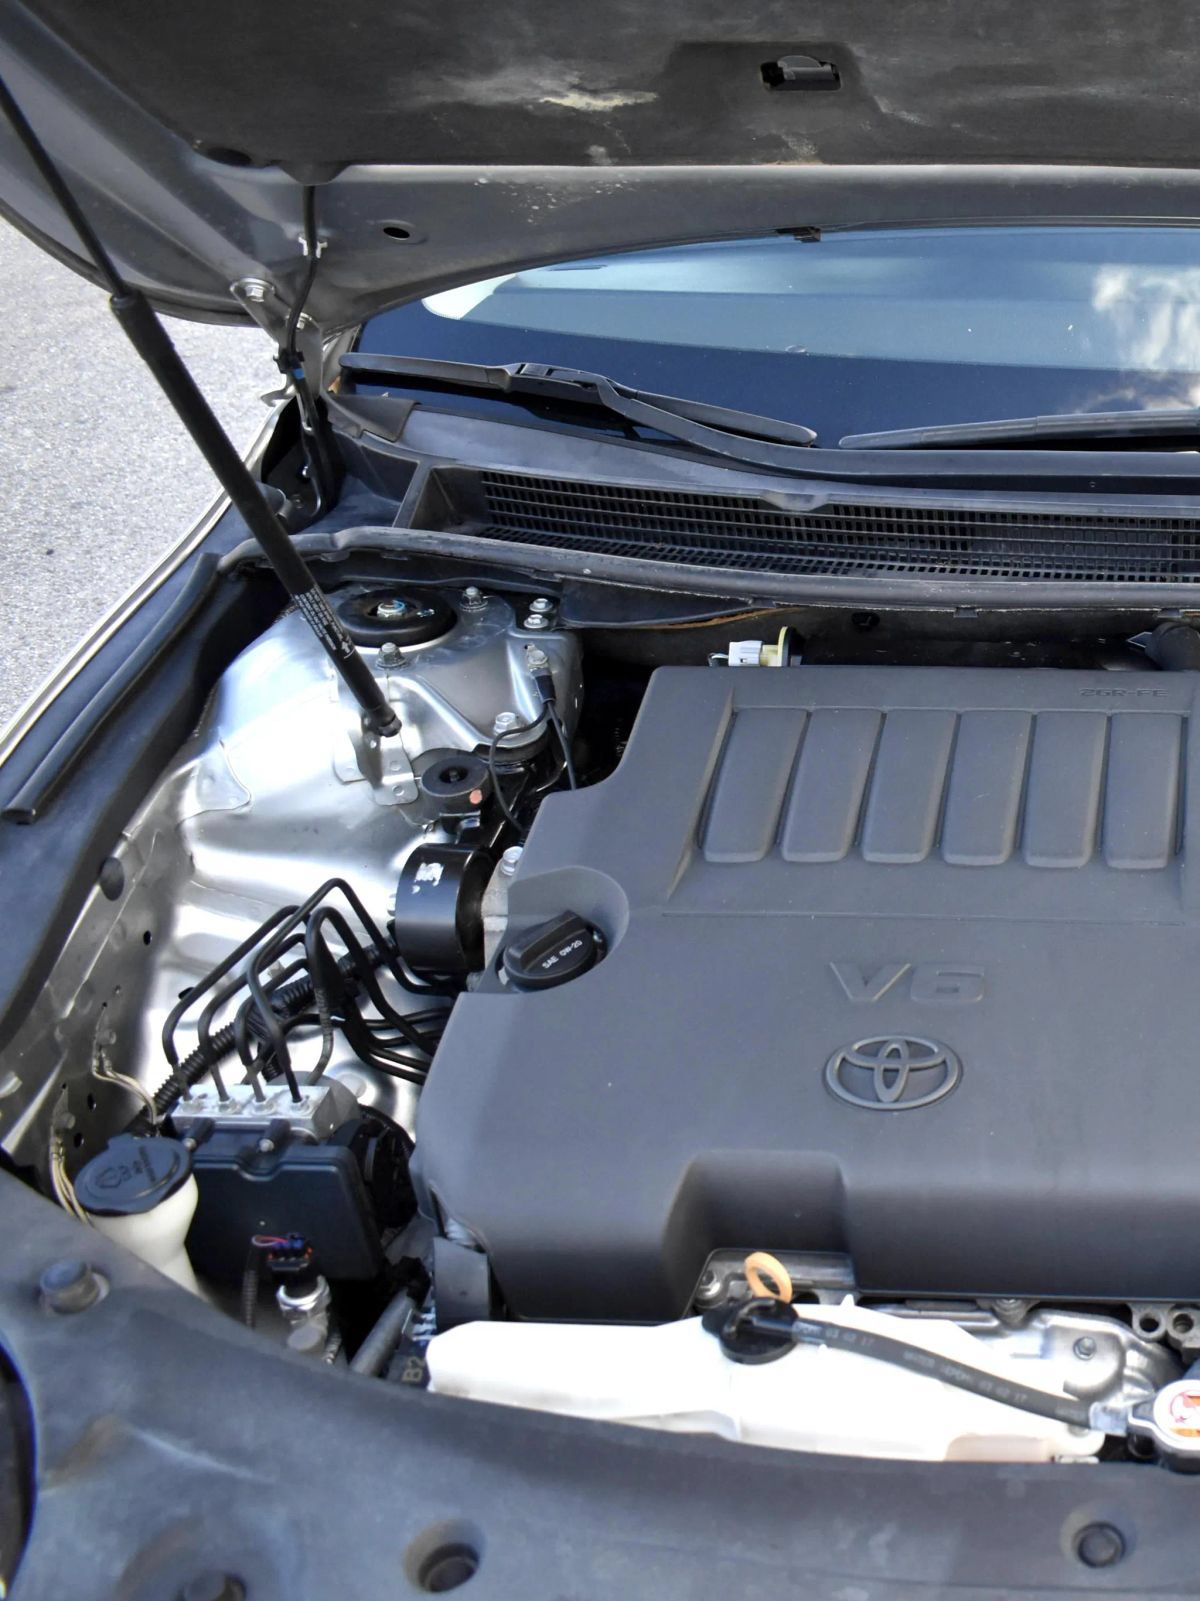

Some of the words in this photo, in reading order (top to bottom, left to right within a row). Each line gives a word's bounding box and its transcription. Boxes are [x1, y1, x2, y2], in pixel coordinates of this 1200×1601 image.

[1079, 688, 1168, 697] 2GR-FE
[542, 956, 559, 969] SAE
[829, 962, 984, 1002] V6
